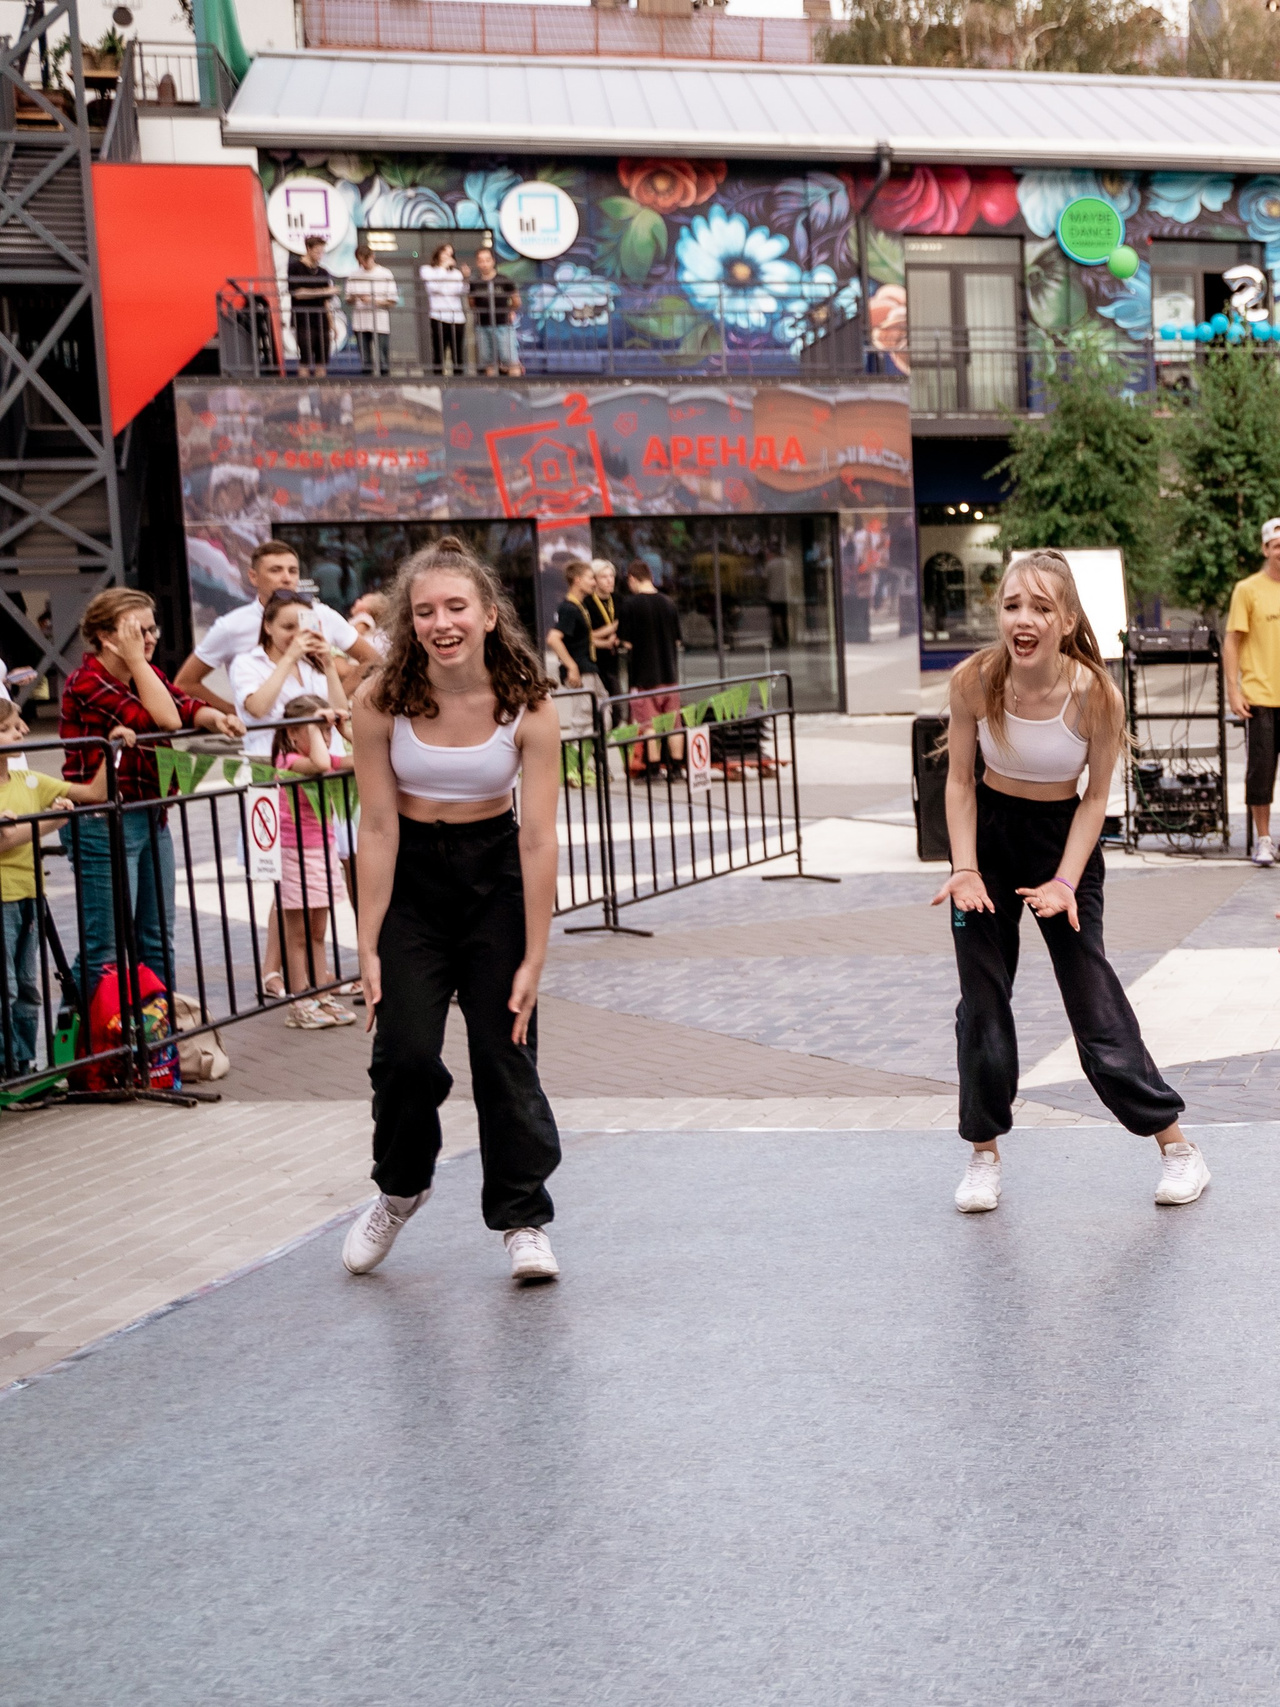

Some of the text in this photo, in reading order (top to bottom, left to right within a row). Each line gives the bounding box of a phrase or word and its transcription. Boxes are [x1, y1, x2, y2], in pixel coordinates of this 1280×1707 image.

[1069, 212, 1112, 222] MAYBE
[1070, 227, 1113, 237] DANCE
[563, 393, 594, 426] 2
[642, 435, 807, 472] АРЕНДА
